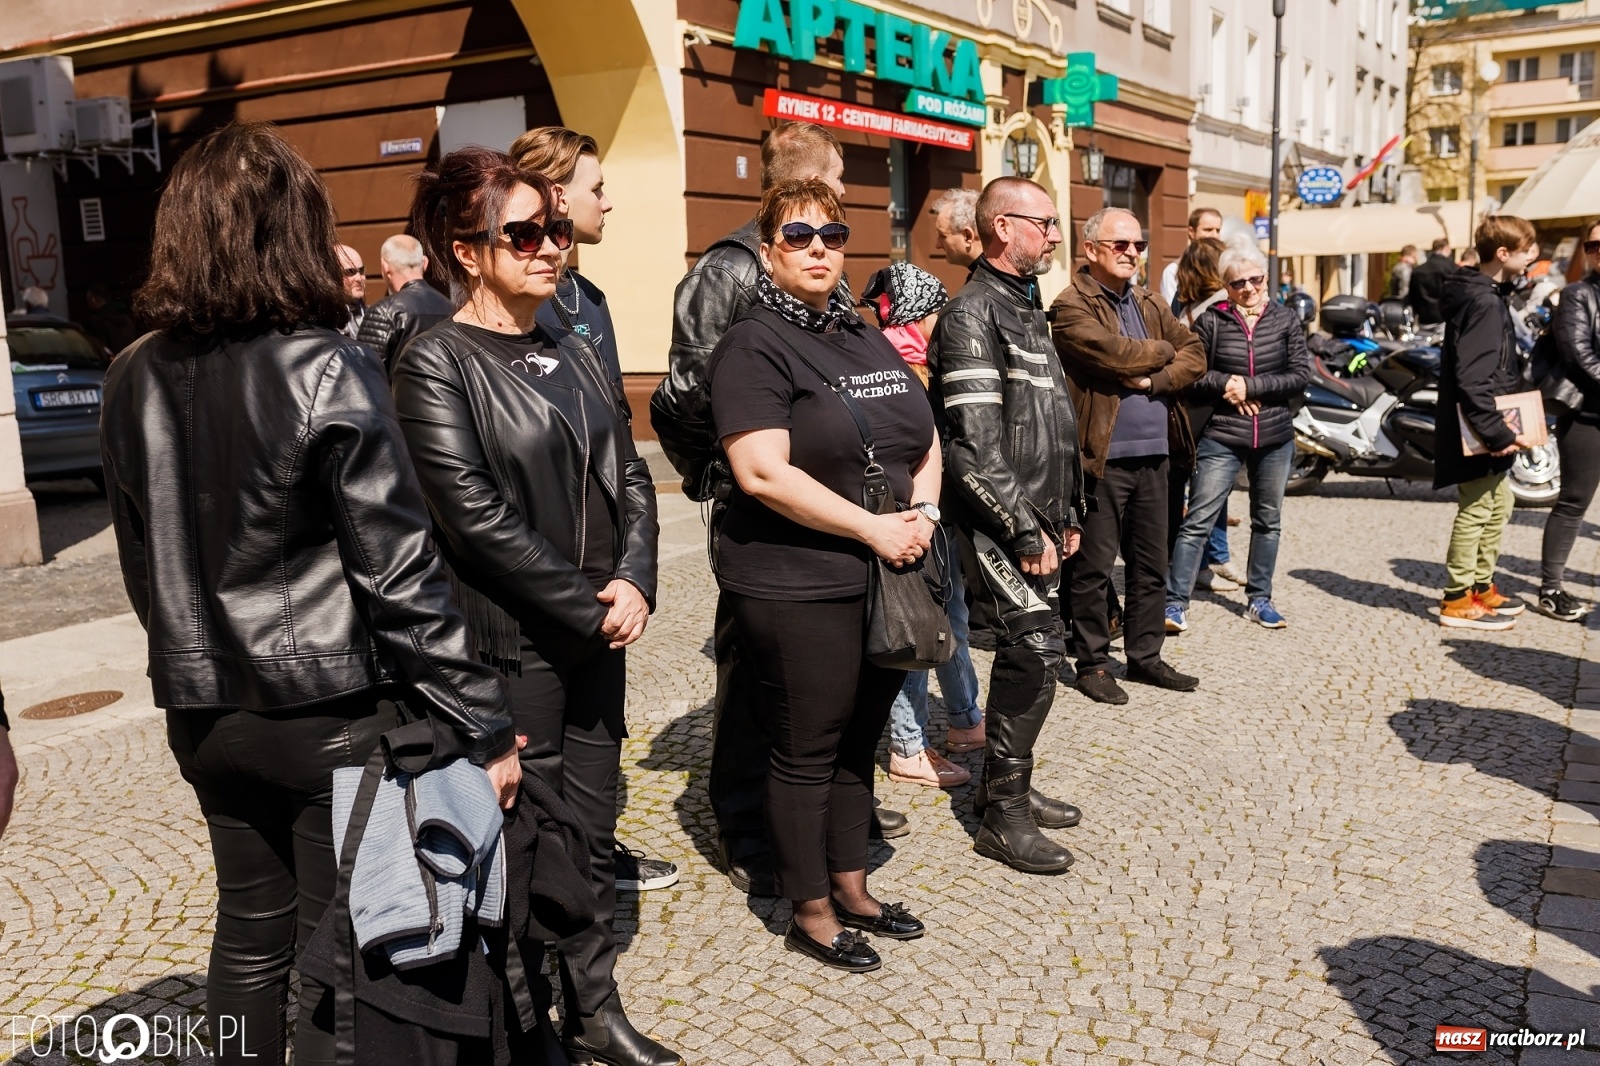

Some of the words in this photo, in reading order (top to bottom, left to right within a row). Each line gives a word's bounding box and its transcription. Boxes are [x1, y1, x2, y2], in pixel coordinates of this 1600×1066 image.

[733, 0, 986, 102] APTEKA
[777, 95, 820, 120] RYNEK
[821, 104, 836, 122] 12
[842, 107, 893, 132] CENTRUM
[893, 117, 971, 147] FARMACEUTYCZNE
[917, 94, 943, 114] POD
[943, 100, 985, 123] RÓŻAMI
[849, 369, 909, 386] MOTOCYK
[984, 547, 1029, 609] RICHA
